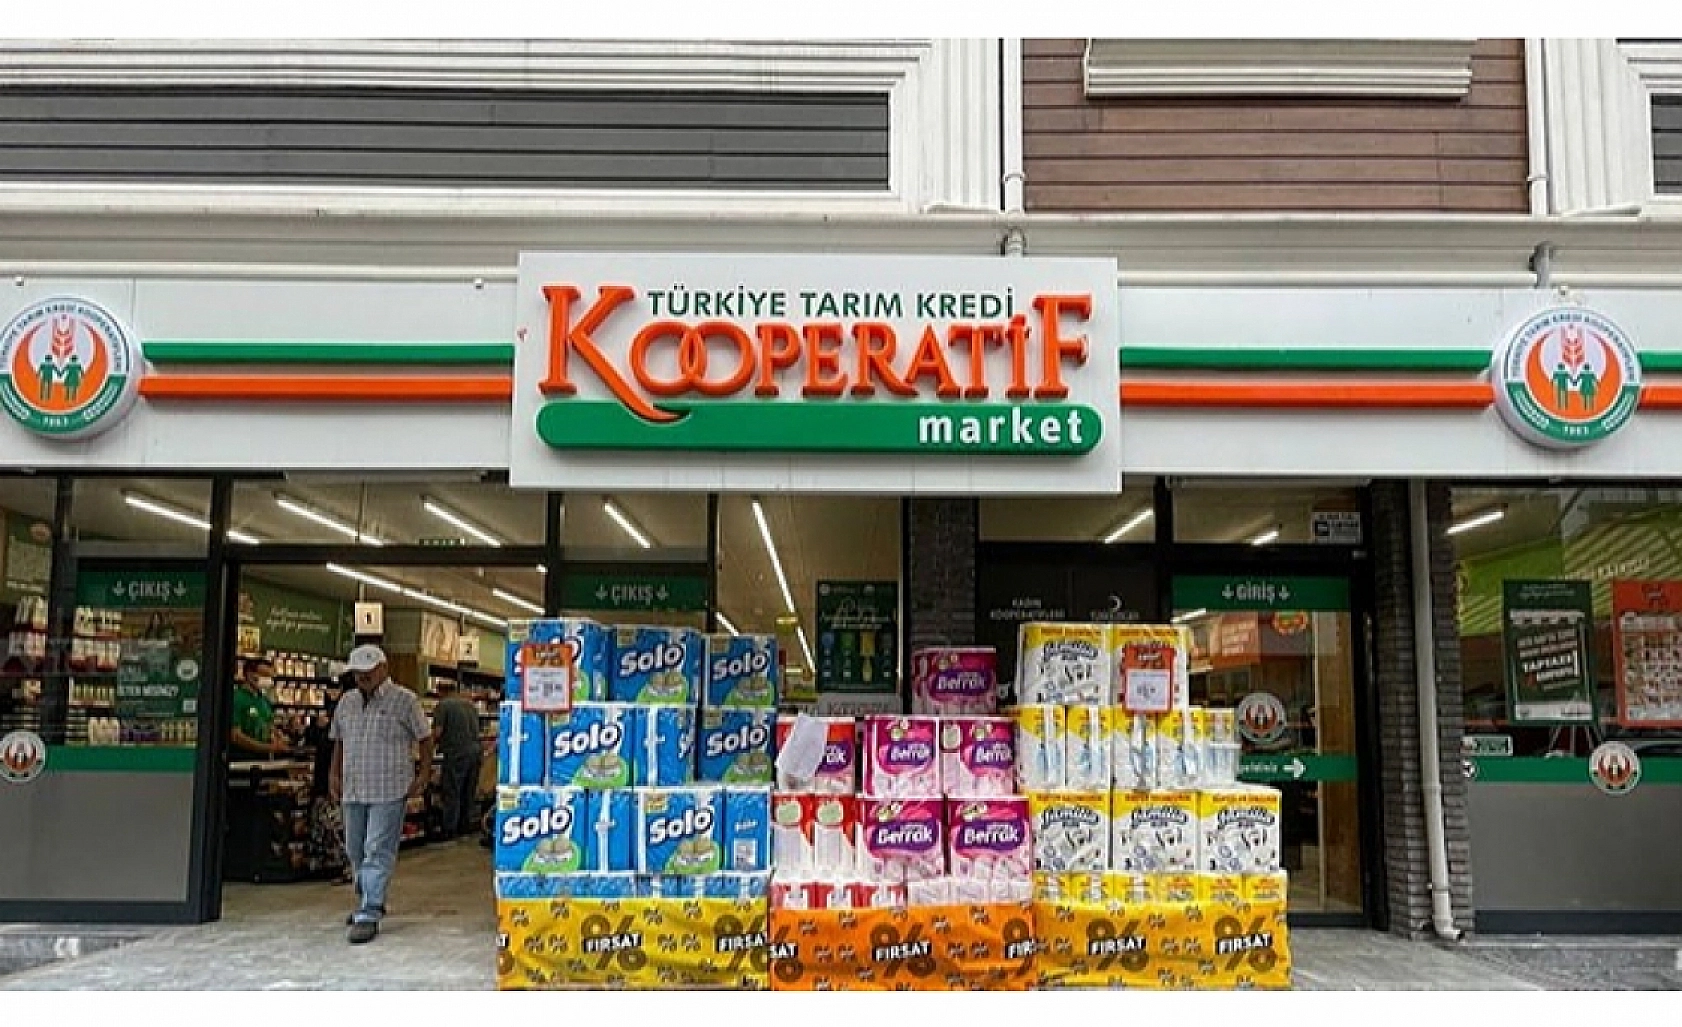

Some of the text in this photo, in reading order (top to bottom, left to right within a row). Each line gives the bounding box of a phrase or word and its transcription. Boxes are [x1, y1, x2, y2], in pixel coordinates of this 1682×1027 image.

[648, 285, 1014, 320] TÜRKİYE TARIM KREDİ
[919, 407, 1086, 446] market
[128, 580, 171, 602] ÇIKIŞ
[612, 585, 654, 606] ÇIKIŞ
[620, 642, 685, 677] Solo
[712, 650, 769, 680] Solo
[554, 723, 621, 759] Solo
[706, 724, 768, 757] Solo
[502, 806, 571, 842] Solo
[649, 808, 714, 843] Solo
[585, 933, 642, 953] FIRSAT
[875, 941, 931, 961] FIRSAT
[1091, 936, 1147, 956] FIRSAT
[1218, 932, 1273, 955] FIRSAT
